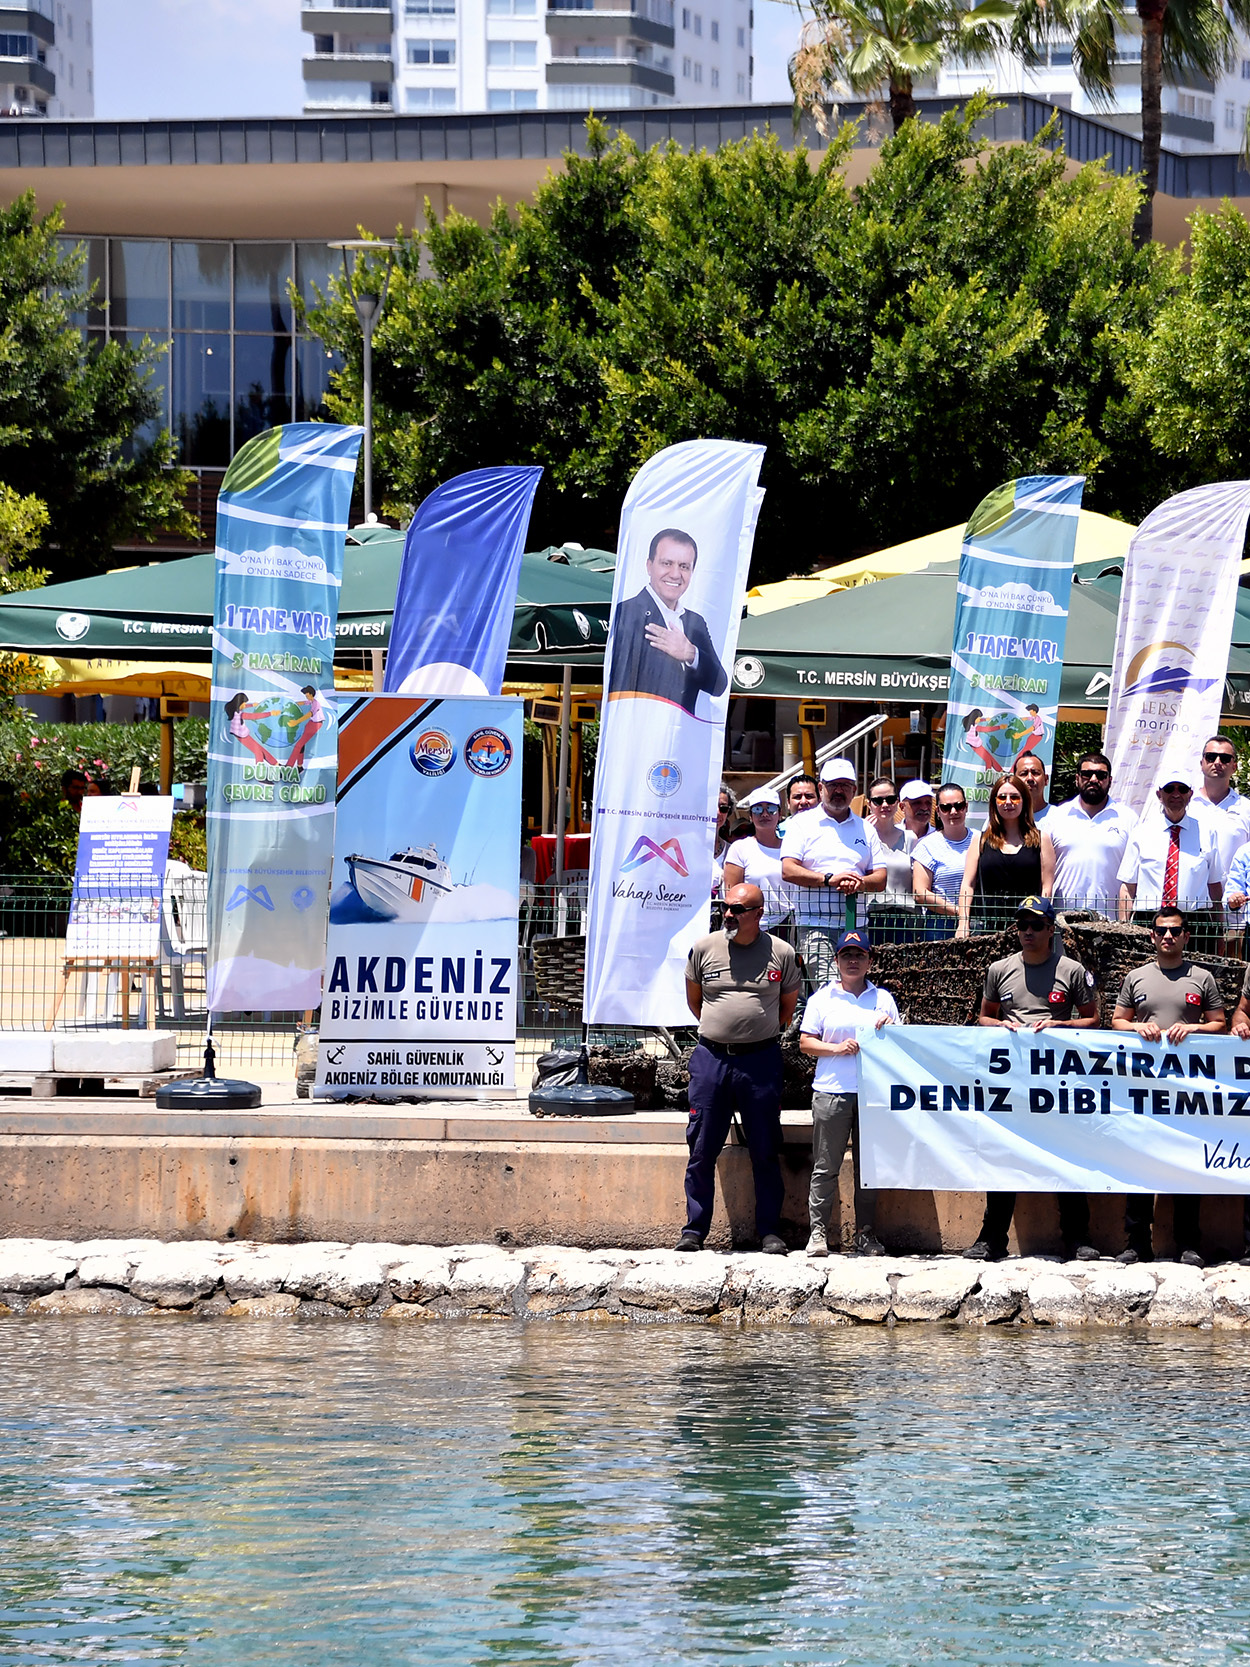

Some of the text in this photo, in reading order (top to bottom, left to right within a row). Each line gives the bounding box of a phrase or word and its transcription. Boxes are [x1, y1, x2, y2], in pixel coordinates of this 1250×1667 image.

[240, 555, 262, 565] O'NA
[276, 557, 293, 567] BAK
[247, 567, 317, 580] O'NDAN SADECE
[980, 590, 999, 599] O'NA
[1011, 593, 1025, 601] BAK
[986, 600, 1045, 613] O'NDAN SADECE
[122, 620, 147, 634] T.C.
[226, 605, 330, 640] 1 TANE VAR!
[967, 632, 1058, 664] 1 TANE VAR!
[231, 652, 322, 674] 5 HAZİRAN
[797, 670, 821, 685] T.C.
[824, 670, 876, 687] MERSİN
[970, 674, 1048, 694] 5 HAZİRAN
[243, 762, 300, 783] DÜNYA
[223, 783, 327, 804] ÇEVRE GÜNÜ
[618, 809, 642, 817] MERSİN
[643, 811, 680, 820] BÜYÜKŞEHİR
[612, 880, 653, 909] Vahap
[328, 949, 512, 994] AKDENİZ
[331, 995, 504, 1021] BİZİMLE GÜVENDE
[367, 1049, 465, 1066] SAHİL GÜVENLİK
[988, 1048, 1012, 1075] 5
[1030, 1044, 1217, 1081] HAZİRAN
[325, 1068, 504, 1086] AKDENİZ BÖLGE KOMUTANLIĞI
[889, 1079, 1013, 1114] DENİZ
[1040, 1080, 1112, 1116] DİBİ
